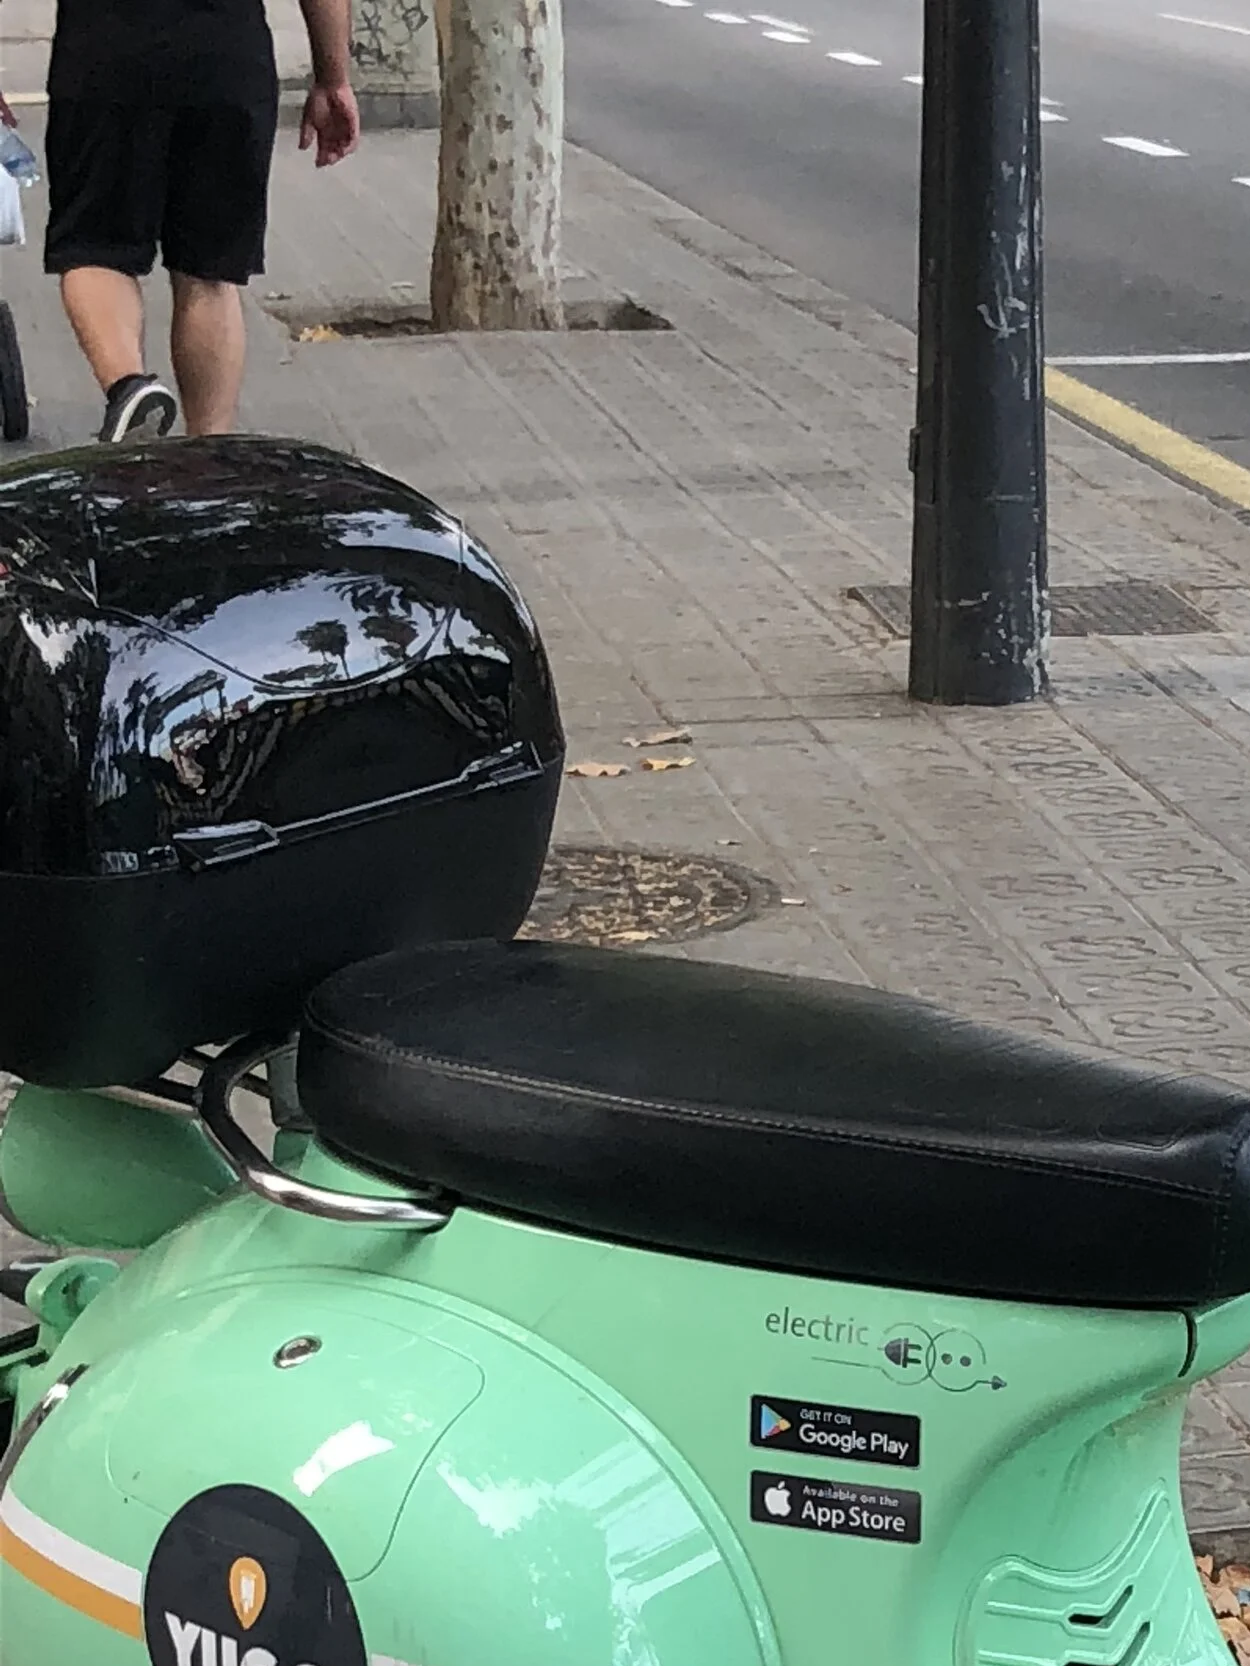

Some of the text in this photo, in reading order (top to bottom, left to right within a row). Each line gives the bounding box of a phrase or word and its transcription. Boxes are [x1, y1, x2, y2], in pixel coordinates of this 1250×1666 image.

[765, 1306, 869, 1346] electric
[800, 1408, 852, 1425] GET IT ON
[799, 1423, 909, 1460] Google Play
[803, 1485, 899, 1507] Available on the
[801, 1500, 906, 1532] App Store
